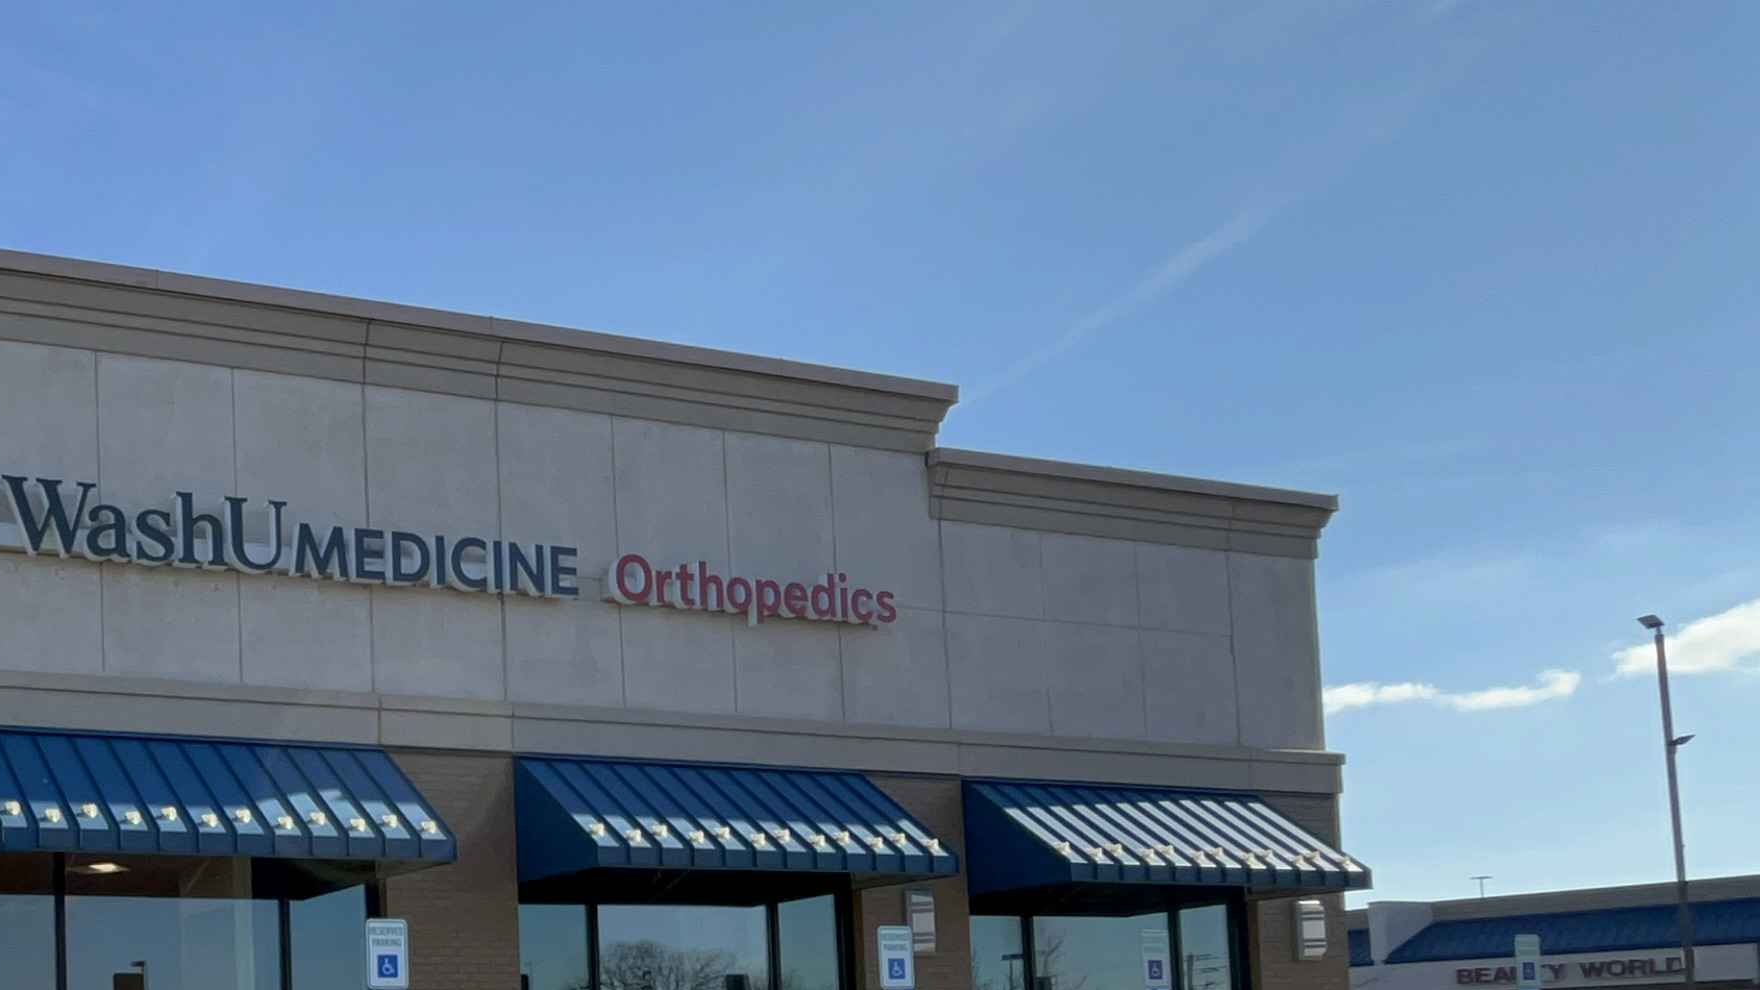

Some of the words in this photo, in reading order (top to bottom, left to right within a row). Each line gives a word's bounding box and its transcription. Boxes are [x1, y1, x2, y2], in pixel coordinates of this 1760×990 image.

[1, 473, 287, 571] WashU
[293, 522, 579, 596] MEDICINE
[614, 553, 897, 625] Orthopedics
[1579, 956, 1687, 979] WORLD
